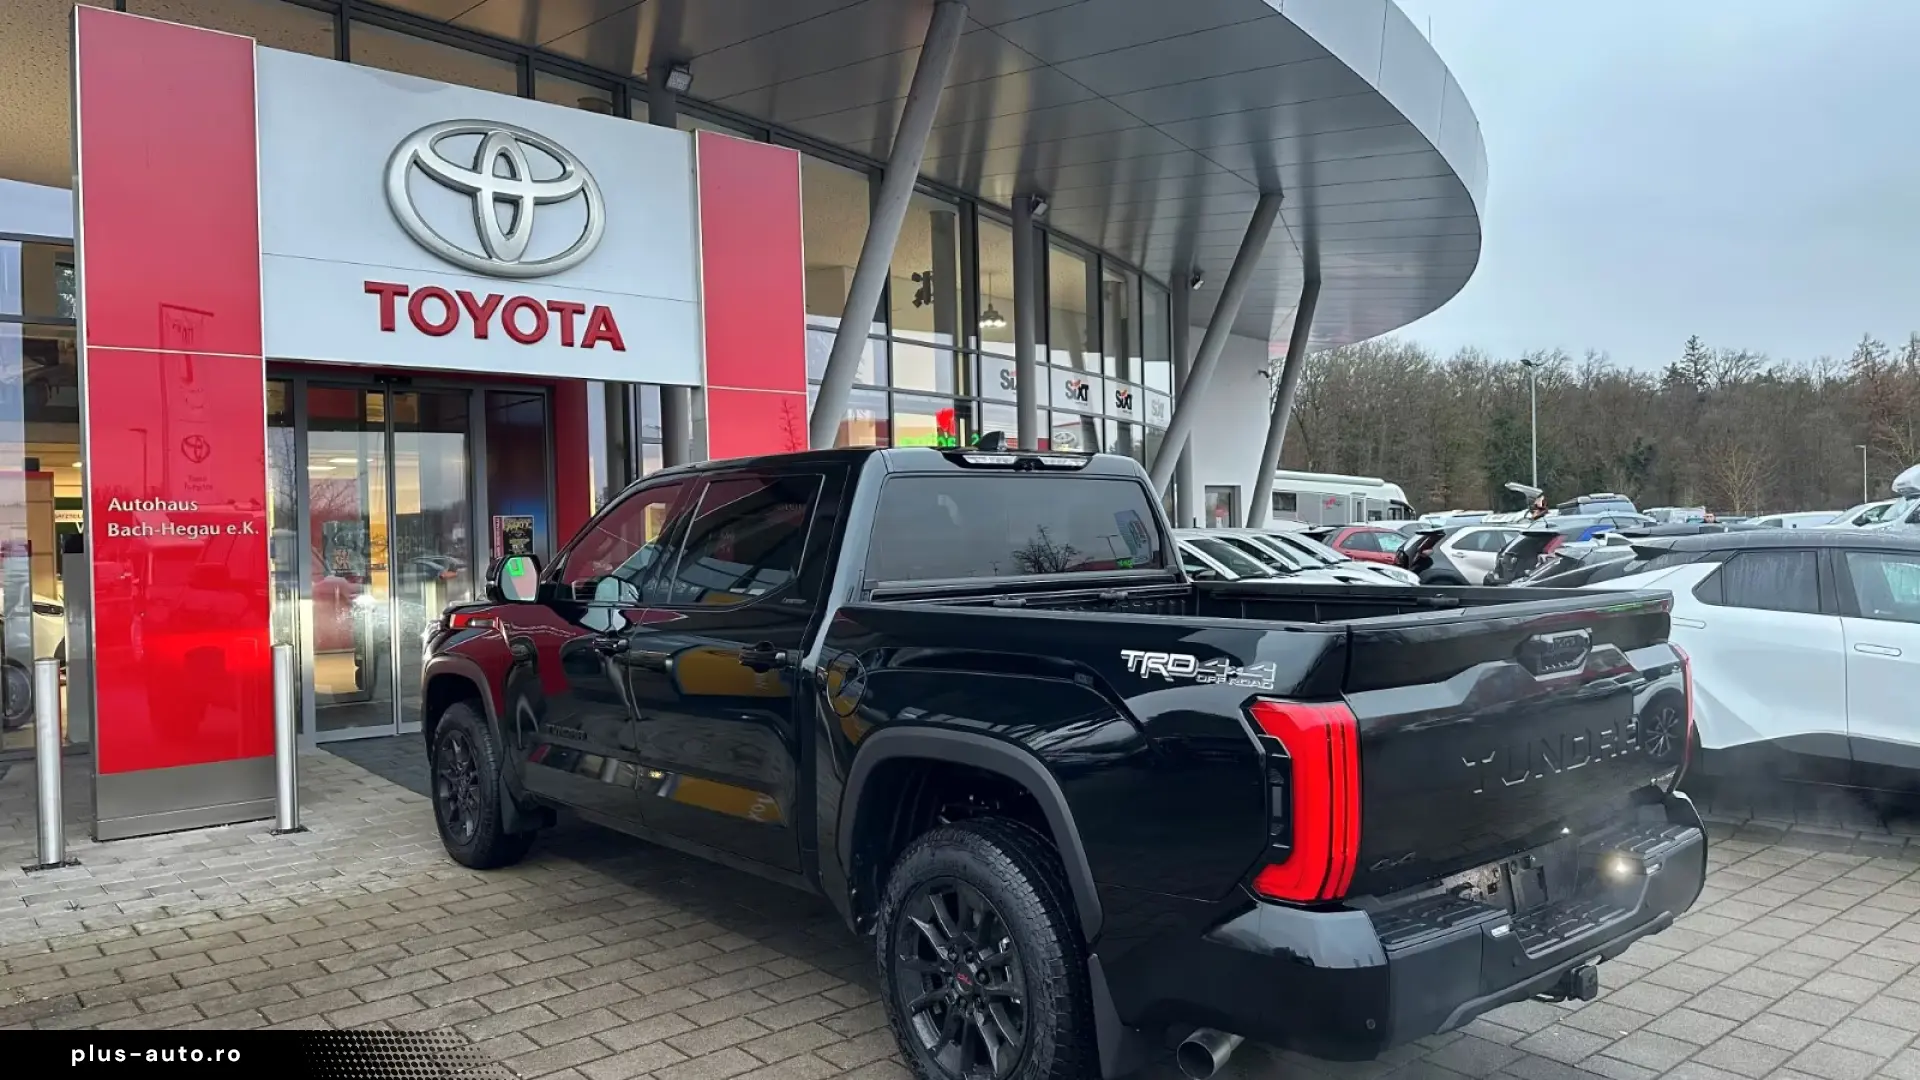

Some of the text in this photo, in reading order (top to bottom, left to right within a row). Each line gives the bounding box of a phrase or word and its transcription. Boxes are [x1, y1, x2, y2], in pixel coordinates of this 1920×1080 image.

[364, 281, 626, 352] TOYOTA
[107, 497, 198, 512] Autohaus
[107, 521, 260, 540] Bach-Hegau e.K.
[1120, 649, 1277, 682] TRD 4x4
[1195, 674, 1274, 690] OFF ROAD
[1461, 714, 1641, 794] TUNDRA
